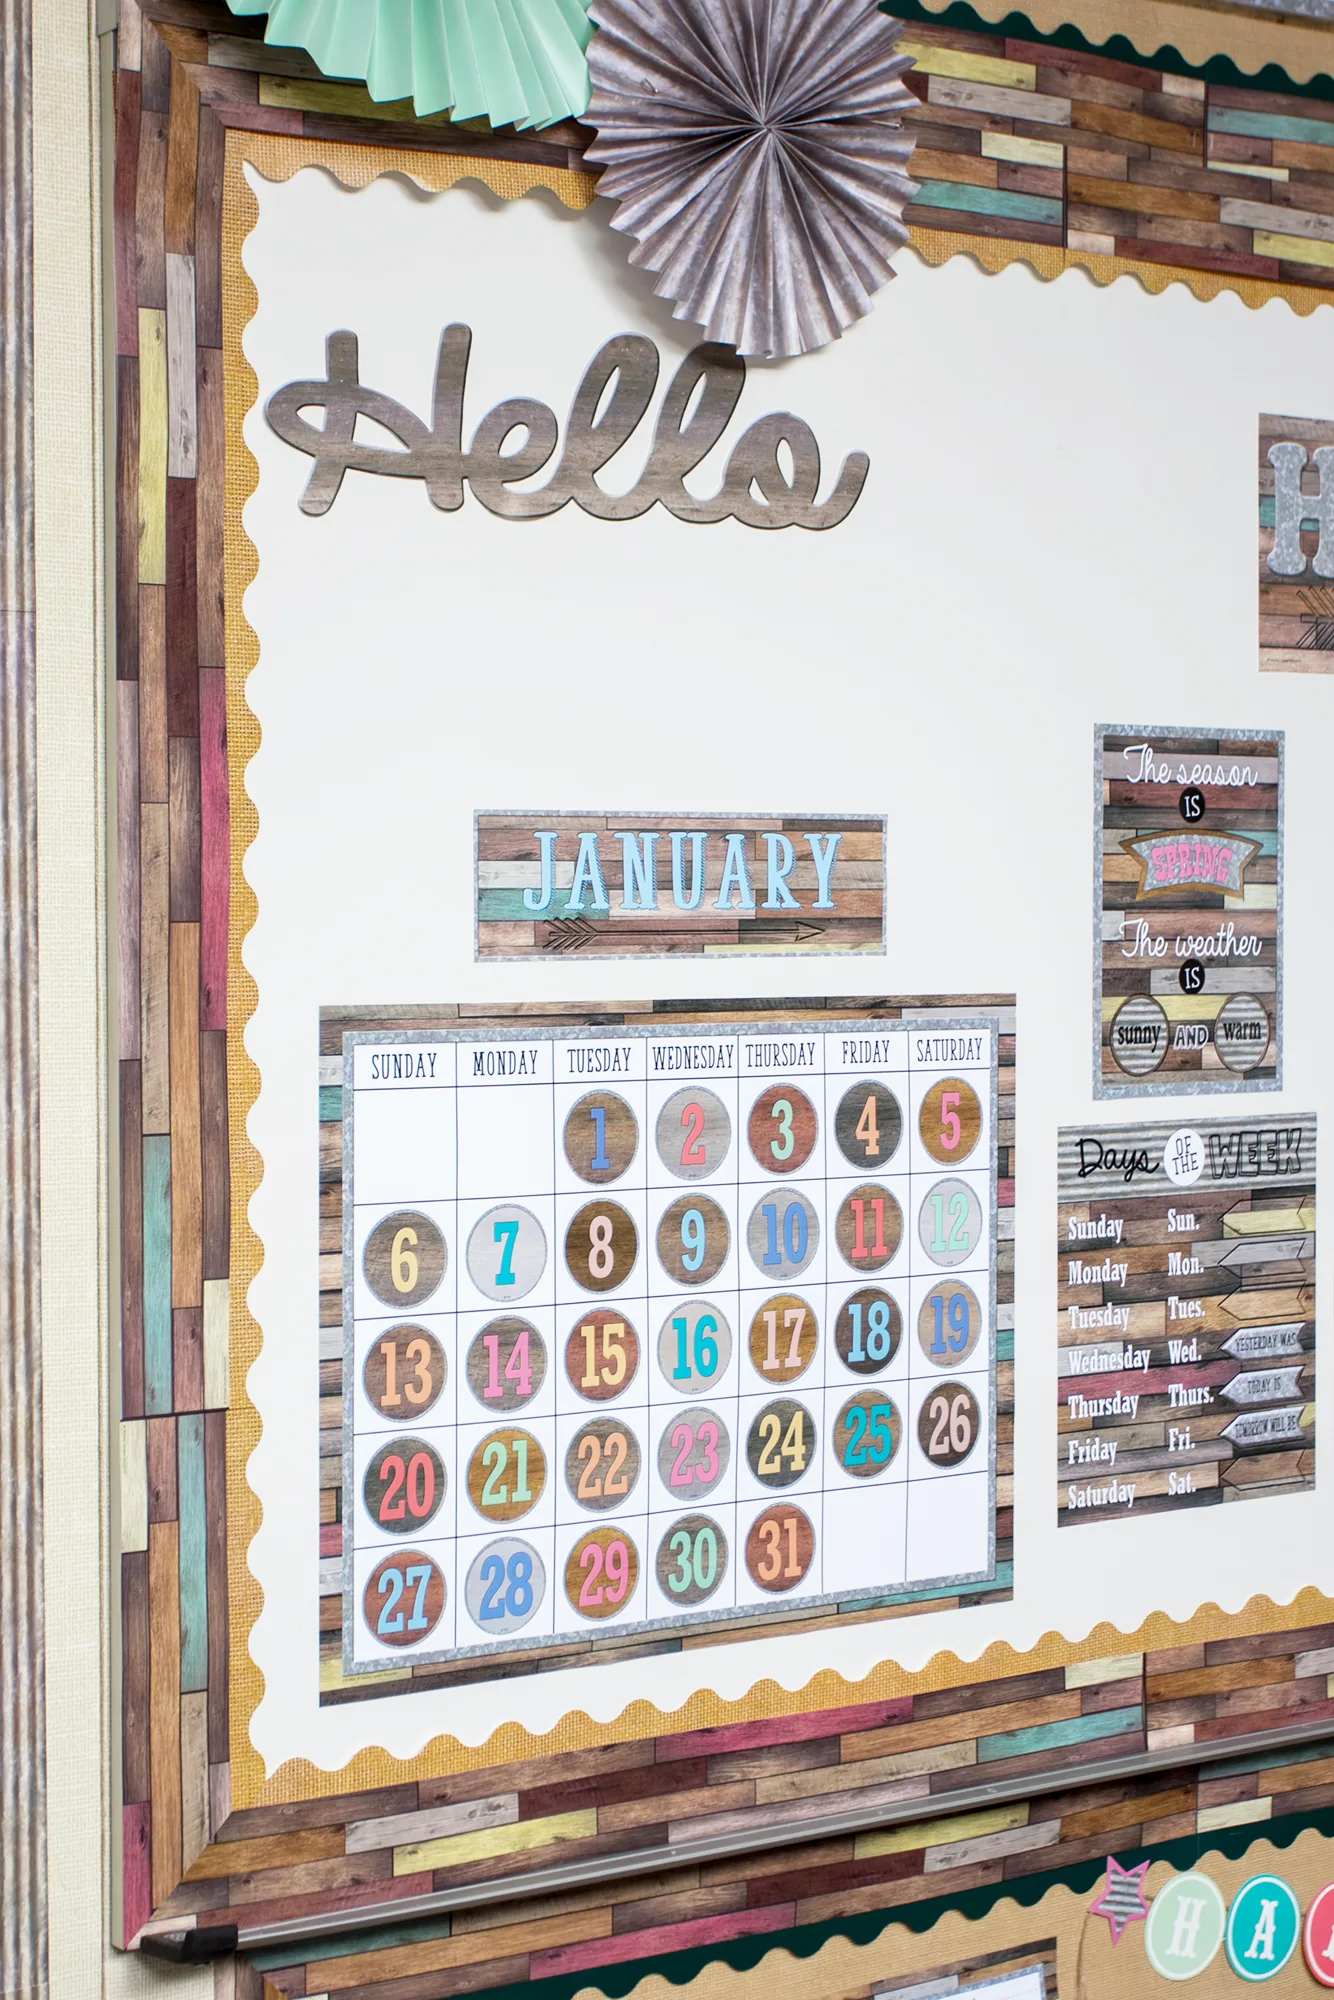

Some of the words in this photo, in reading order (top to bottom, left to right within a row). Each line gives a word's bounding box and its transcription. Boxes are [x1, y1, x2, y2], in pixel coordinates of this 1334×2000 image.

[264, 321, 871, 531] Hello
[1123, 743, 1171, 786] The
[1176, 761, 1259, 788] season
[1184, 794, 1200, 818] IS
[523, 832, 843, 911] JANUARY
[1151, 842, 1233, 882] SPRING
[1119, 918, 1168, 958] The
[1175, 922, 1263, 958] weather
[1184, 967, 1200, 989] IS
[1117, 1023, 1161, 1052] sunny
[1174, 1025, 1209, 1050] AND
[1223, 1021, 1262, 1042] warm
[372, 1053, 437, 1079] SUNDAY
[473, 1050, 538, 1076] MONDAY
[567, 1047, 631, 1073] TUESDAY
[652, 1044, 734, 1070] WEDNESDAY
[745, 1042, 816, 1067] THURSDAY
[842, 1040, 890, 1064] FRIDAY
[917, 1038, 982, 1062] SATURDAY
[590, 1107, 610, 1170] 1
[680, 1102, 706, 1165] 2
[770, 1099, 795, 1161] 3
[855, 1096, 880, 1155] 4
[939, 1092, 961, 1150] 5
[1175, 1135, 1192, 1156] OF
[1075, 1137, 1160, 1182] Days
[1172, 1153, 1199, 1175] THE
[1209, 1128, 1302, 1180] WEEK
[391, 1227, 418, 1293] 6
[494, 1221, 519, 1285] 7
[588, 1216, 614, 1279] 8
[680, 1209, 706, 1272] 9
[762, 1202, 808, 1265] 10
[851, 1198, 888, 1258] 11
[930, 1192, 969, 1253] 12
[1068, 1214, 1123, 1243] Sunday
[1167, 1209, 1200, 1234] Sun.
[1068, 1259, 1128, 1287] Monday
[1167, 1252, 1204, 1277] Mon.
[1068, 1302, 1130, 1331] Tuesday
[1167, 1296, 1206, 1321] Tues.
[379, 1338, 432, 1407] 13
[482, 1331, 533, 1398] 14
[580, 1322, 626, 1388] 15
[672, 1315, 719, 1380] 16
[762, 1308, 806, 1370] 17
[847, 1300, 891, 1363] 18
[930, 1293, 970, 1355] 19
[1068, 1346, 1151, 1375] Wednesday
[1167, 1339, 1202, 1365] Wed.
[1235, 1334, 1278, 1352] YESTERDAY
[1280, 1332, 1297, 1346] WAS
[1068, 1391, 1139, 1420] Thursday
[1168, 1383, 1214, 1409] Thurs.
[1248, 1378, 1271, 1394] TODAY
[1274, 1377, 1281, 1391] IS
[1235, 1417, 1268, 1438] TOMORROW
[1270, 1415, 1285, 1433] WILL
[1287, 1415, 1297, 1431] BE
[379, 1452, 434, 1520] 20
[481, 1439, 532, 1506] 21
[577, 1432, 628, 1499] 22
[669, 1421, 720, 1487] 23
[758, 1411, 806, 1475] 24
[845, 1403, 893, 1467] 25
[929, 1394, 971, 1456] 26
[1068, 1438, 1118, 1465] Friday
[1168, 1427, 1195, 1452] Fri.
[1068, 1480, 1136, 1509] Saturday
[1168, 1471, 1196, 1496] Sat.
[377, 1564, 432, 1635] 27
[479, 1551, 533, 1621] 28
[578, 1539, 628, 1607] 29
[667, 1527, 718, 1593] 30
[757, 1517, 801, 1581] 31
